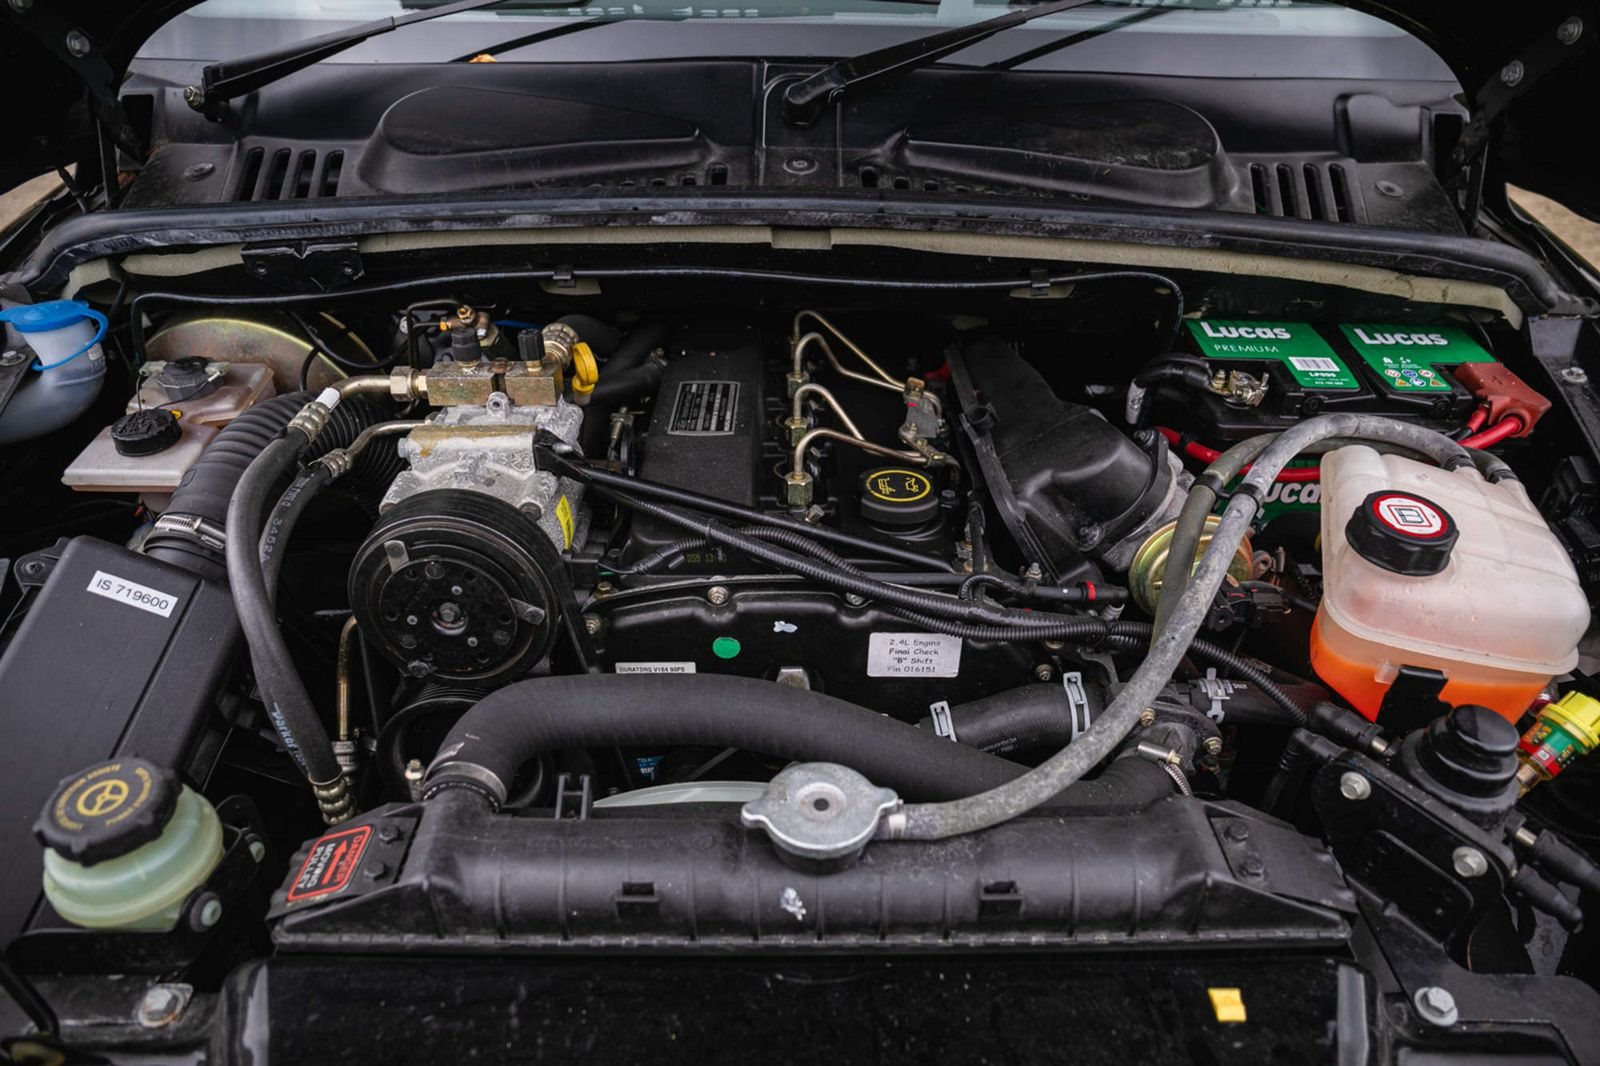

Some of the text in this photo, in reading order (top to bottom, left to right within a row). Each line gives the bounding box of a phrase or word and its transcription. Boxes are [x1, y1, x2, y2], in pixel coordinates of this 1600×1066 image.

[1200, 321, 1291, 340] Lucas
[1353, 328, 1448, 346] Lucas
[1213, 344, 1280, 353] PREMIUM
[1262, 482, 1321, 504] uca
[96, 578, 169, 610] IS 719600
[913, 638, 941, 648] Engine
[910, 657, 933, 665] Shift
